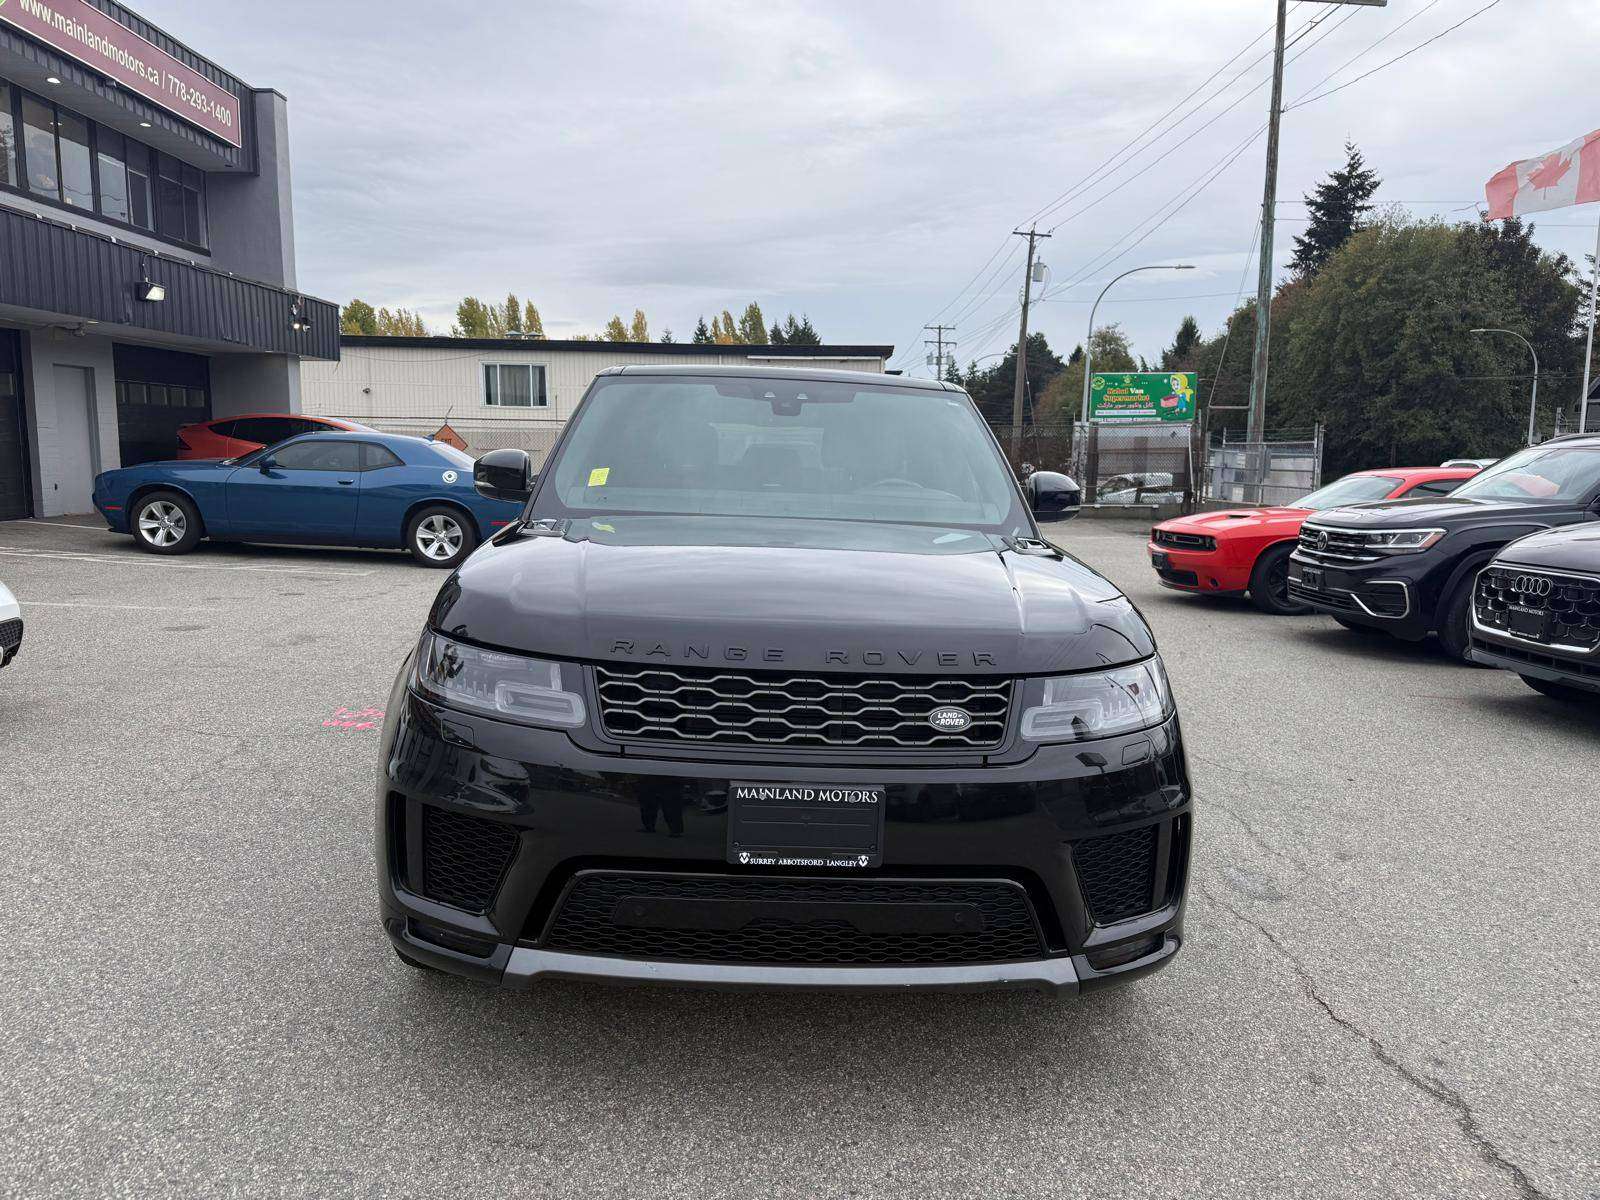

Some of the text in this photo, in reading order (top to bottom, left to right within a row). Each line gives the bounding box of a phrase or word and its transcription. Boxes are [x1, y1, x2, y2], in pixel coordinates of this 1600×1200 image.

[19, 0, 159, 86] www.mainlandmotors.ca
[168, 74, 232, 127] 778-293-1400
[611, 640, 997, 667] RANGE ROVER
[736, 787, 878, 803] MAINLAND MOTORS
[750, 856, 776, 866] SURREY
[778, 857, 824, 866] ABBOTSFORD
